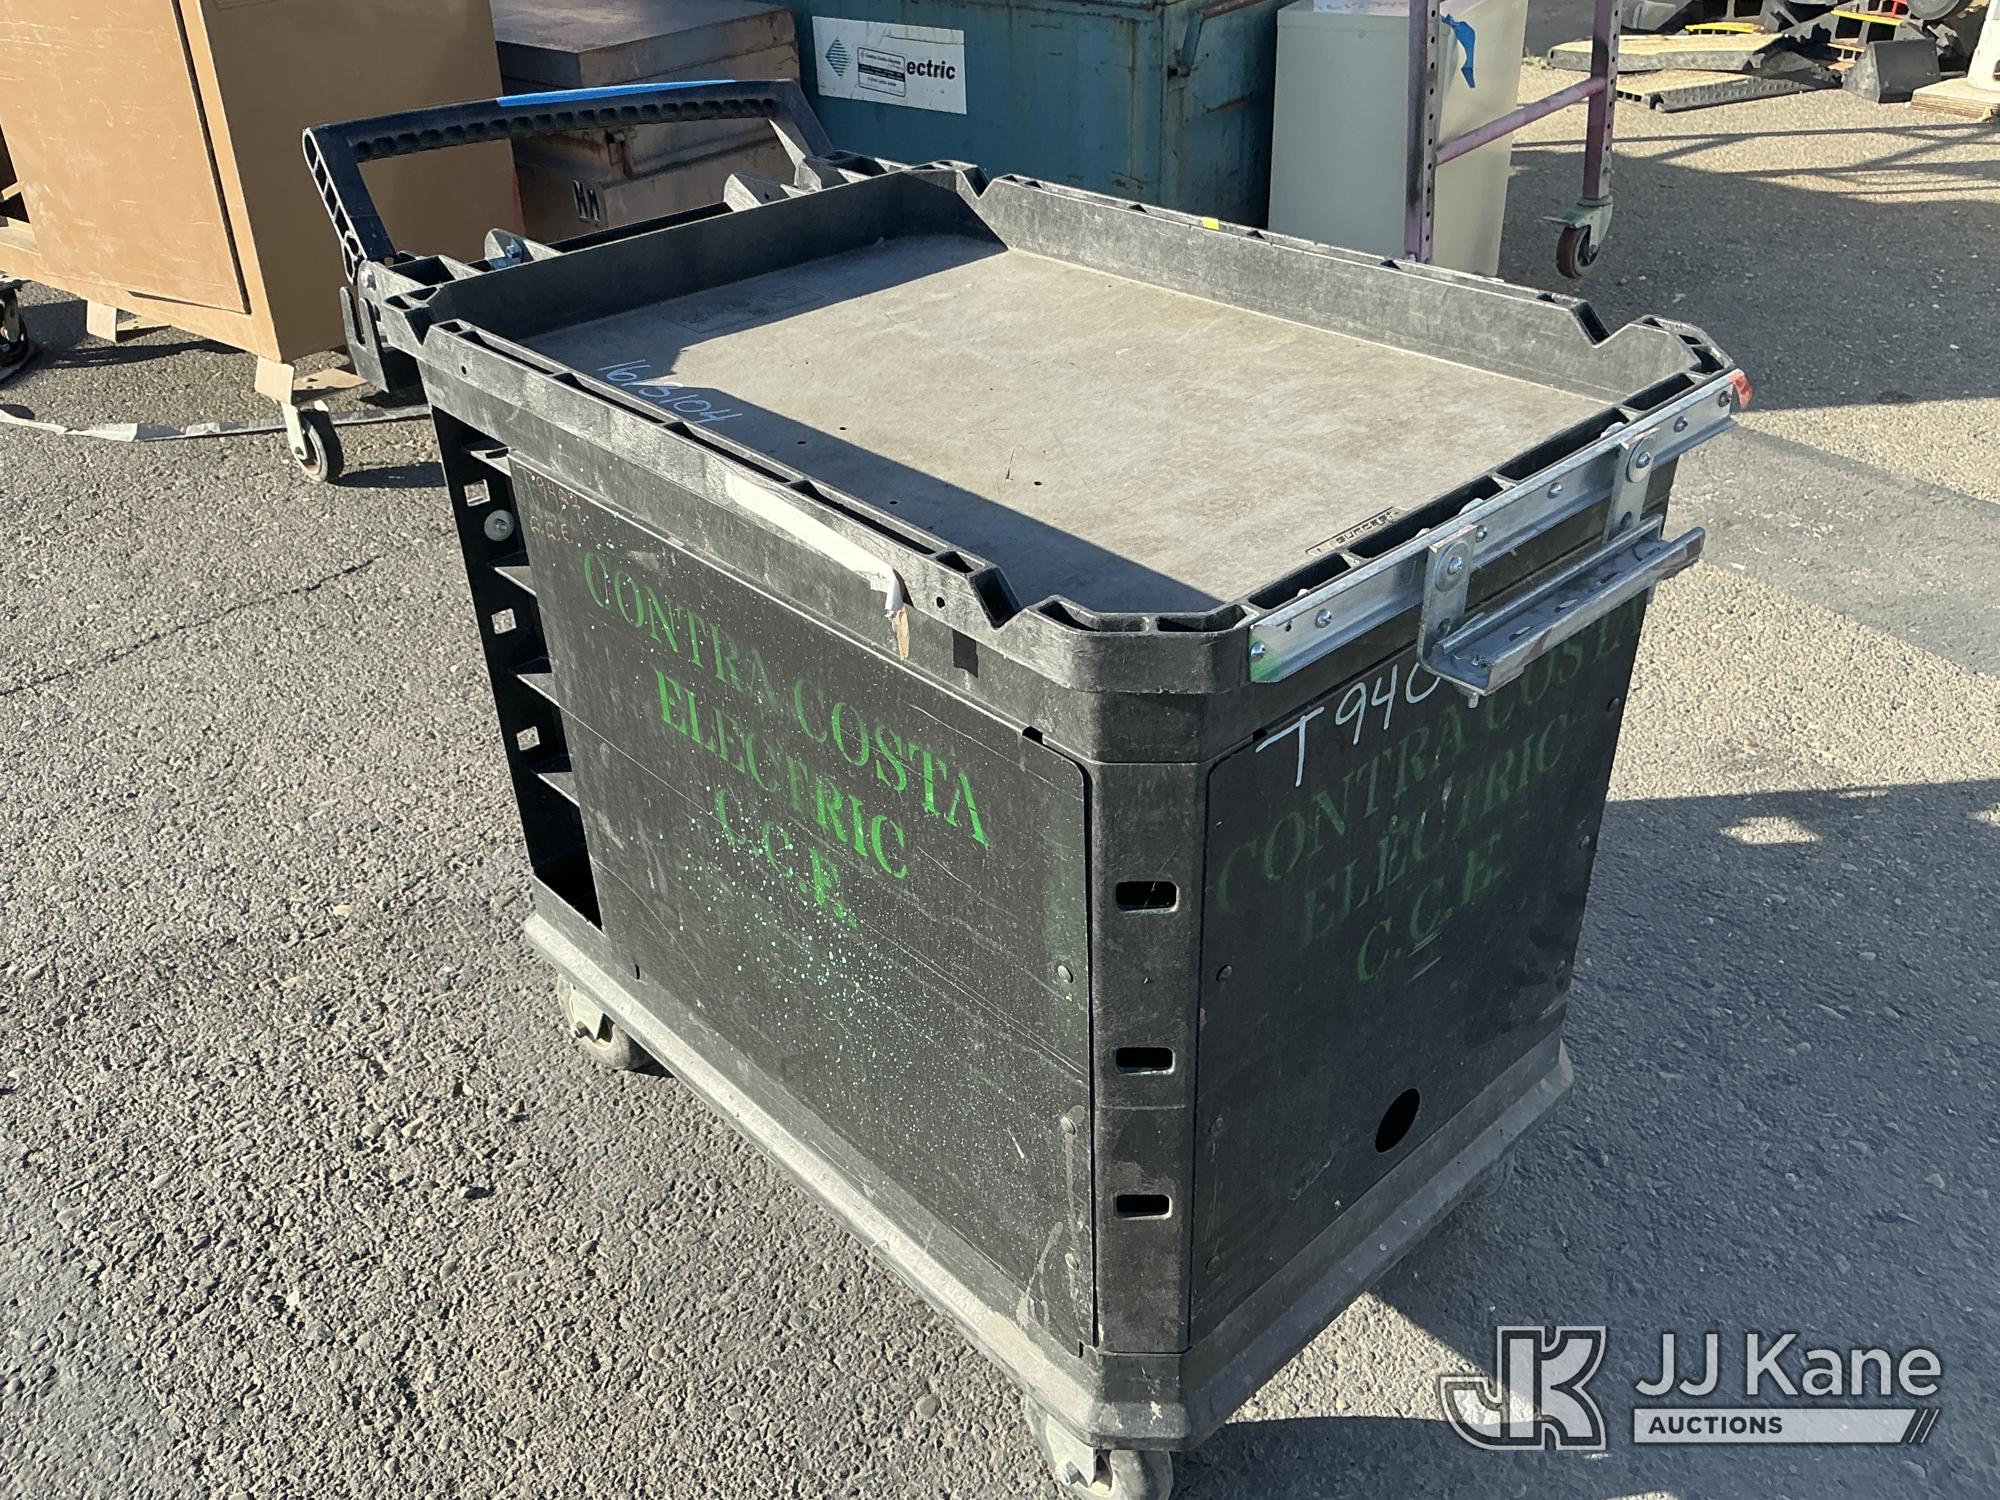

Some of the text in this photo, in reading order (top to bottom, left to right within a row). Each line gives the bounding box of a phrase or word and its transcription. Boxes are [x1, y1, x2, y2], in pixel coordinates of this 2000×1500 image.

[907, 60, 956, 81] ectric
[584, 553, 990, 850] CONTRA COSTA
[654, 666, 908, 878] ELECTRIC
[1218, 704, 1467, 915] CONTRA
[1301, 714, 1565, 945] ELECTRIC
